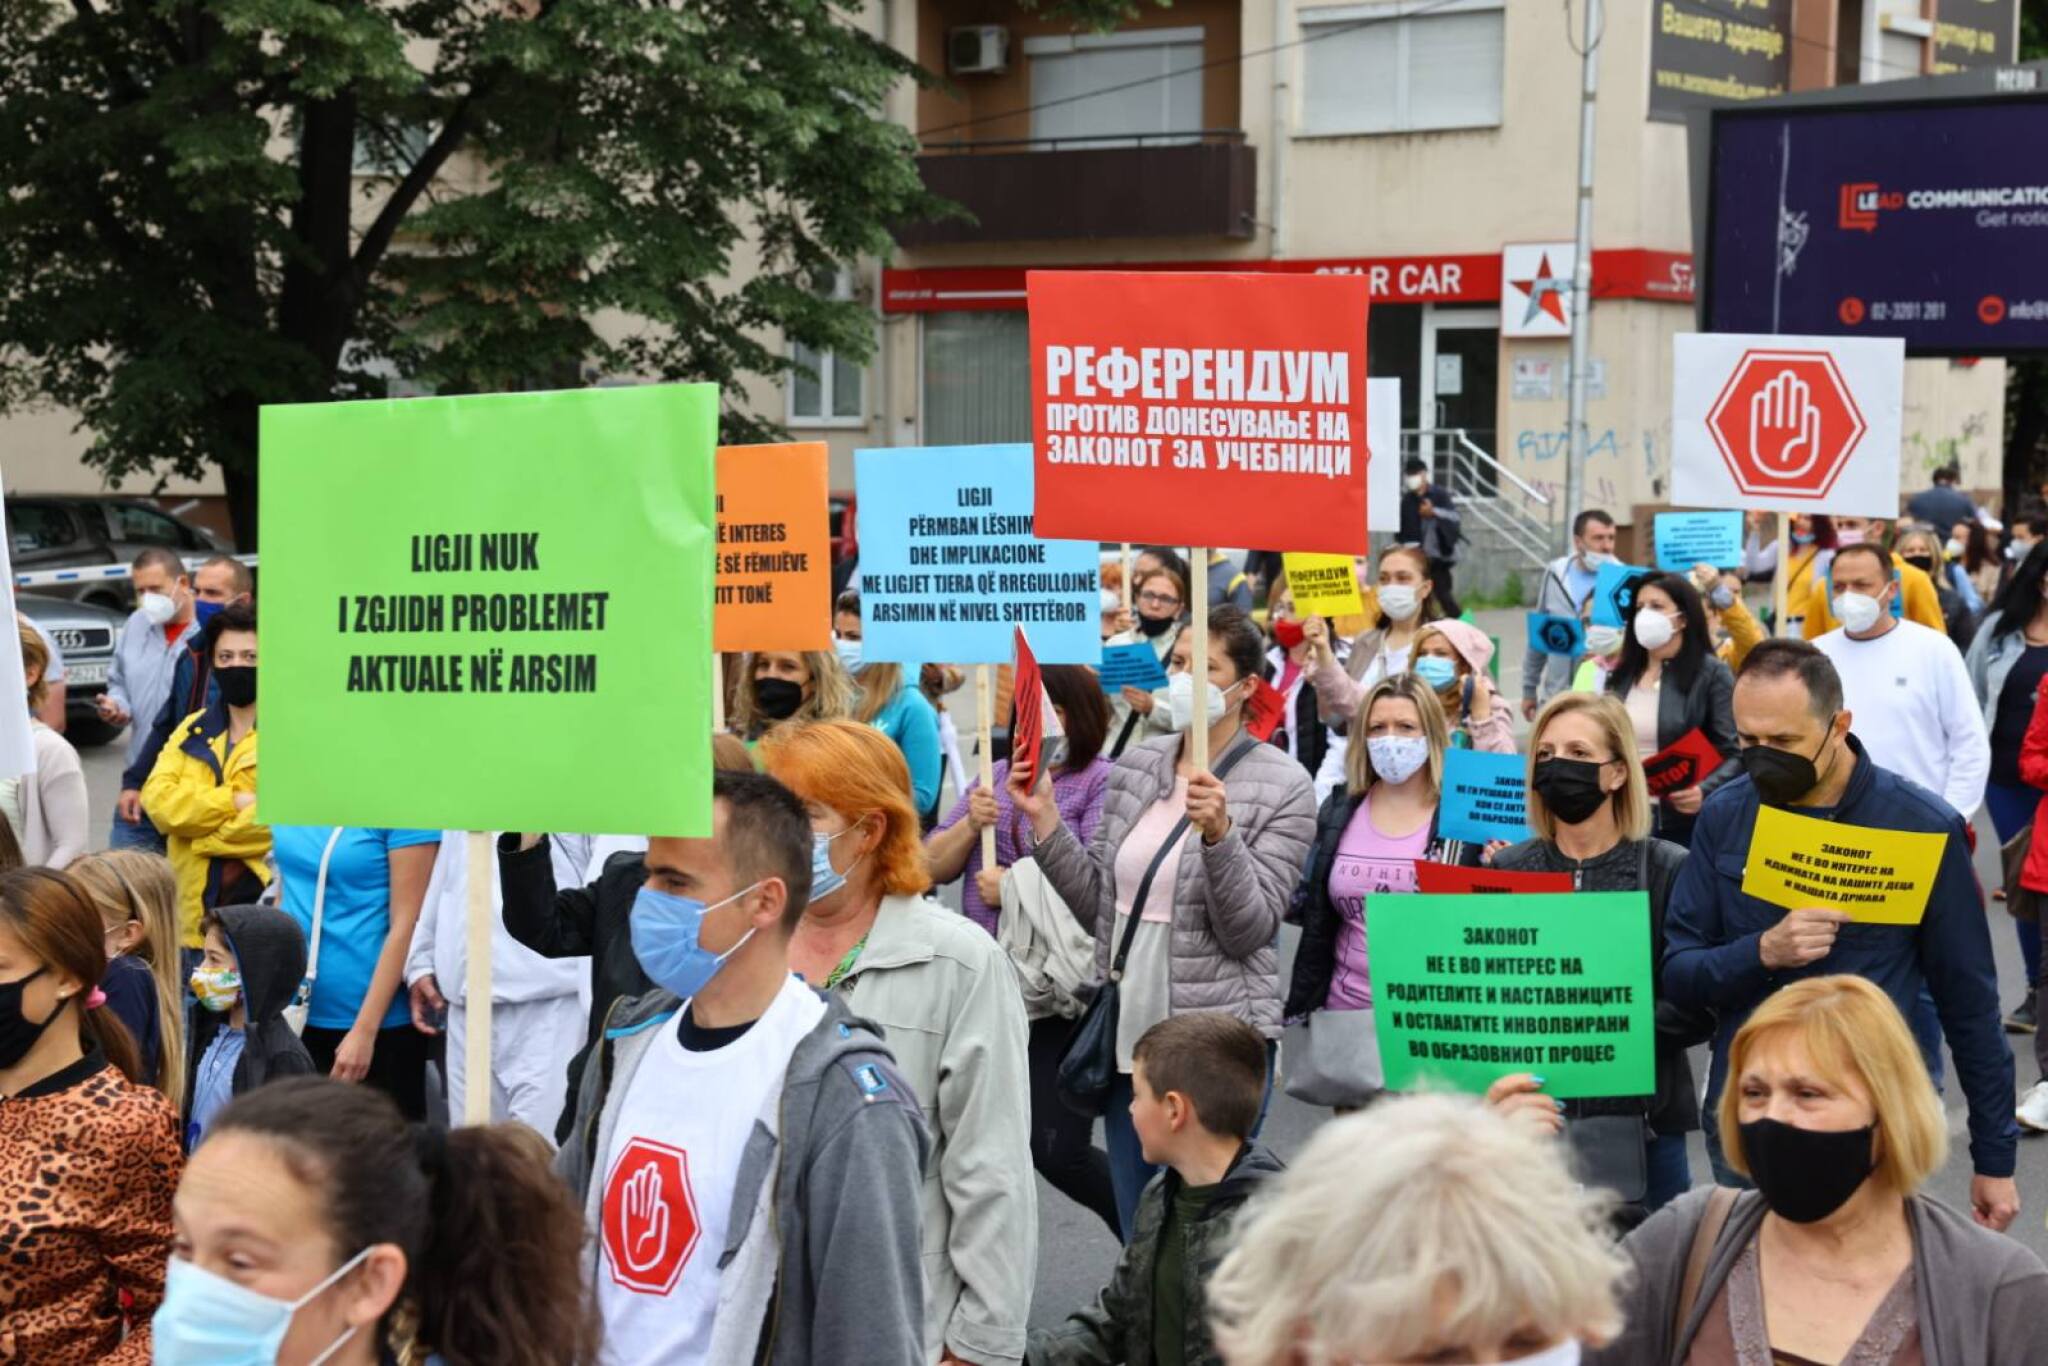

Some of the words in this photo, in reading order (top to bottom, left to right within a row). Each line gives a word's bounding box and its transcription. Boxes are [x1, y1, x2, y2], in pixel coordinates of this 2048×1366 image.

[1662, 2, 1723, 43] Вашето
[1858, 191, 1904, 211] LEAD
[1976, 210, 2007, 228] Get
[1400, 263, 1462, 296] CAR
[1046, 345, 1349, 405] РЕФЕРЕНДУМ
[1046, 402, 1140, 435] ПРОТИВ
[1145, 405, 1312, 440] ДОНЕСУВАЊЕ
[1317, 411, 1350, 441] НА
[1046, 434, 1162, 468] ЗАКОНОТ
[1172, 439, 1206, 469] ЗА
[1216, 441, 1351, 479] УЧЕБНИЦИ
[957, 487, 992, 507] LIGJI
[729, 523, 786, 543] INTERES
[909, 514, 979, 537] PËRMBAN
[411, 534, 472, 572] LIGJI
[480, 532, 539, 571] NUK
[724, 552, 741, 574] SË
[744, 551, 808, 573] FËMIJËVE
[910, 545, 938, 565] DHE
[941, 544, 1046, 565] IMPLIKACIONE
[737, 582, 772, 604] TONË
[862, 575, 882, 594] ME
[885, 574, 930, 594] LIGJET
[934, 573, 974, 593] TJERA
[978, 570, 996, 595] QË
[1000, 569, 1097, 593] RREGULLOJNË
[339, 596, 347, 633] I
[354, 595, 444, 633] ZGJIDH
[452, 592, 609, 632] PROBLEMET
[872, 603, 935, 622] ARSIMIN
[940, 599, 957, 622] NË
[959, 602, 1000, 622] NIVEL
[1003, 599, 1086, 622] SHTETËROR
[346, 654, 463, 693] AKTUALE
[470, 648, 503, 693] NË
[509, 654, 597, 693] ARSIM
[1791, 851, 1804, 864] НЕ
[1805, 854, 1813, 866] Е
[1814, 855, 1829, 868] ВО
[1831, 860, 1878, 876] ИНТЕРЕС
[1880, 866, 1894, 876] НА
[1821, 843, 1872, 860] ЗАКОНОТ
[1764, 857, 1821, 882] ИДНИНАТА
[1823, 874, 1837, 886] НА
[1839, 878, 1883, 891] НАШИТЕ
[1884, 880, 1915, 891] ДЕЦА
[1784, 879, 1792, 889] И
[1794, 881, 1838, 901] НАШАТА
[1839, 891, 1886, 903] ДРЖАВА
[1463, 926, 1539, 946] ЗАКОНОТ
[1426, 955, 1445, 974] НЕ
[1448, 956, 1457, 974] Е
[1460, 956, 1481, 975] ВО
[1485, 956, 1556, 975] ИНТЕРЕС
[1561, 957, 1584, 976] НА
[1387, 982, 1482, 1004] РОДИТЕЛИТЕ
[1486, 985, 1496, 1003] И
[1501, 986, 1633, 1007] НАСТАВНИЦИТЕ
[1392, 1011, 1402, 1029] И
[1405, 1011, 1500, 1034] ОСТАНАТИТЕ
[1503, 1015, 1629, 1035] ИНВОЛВИРАНИ
[1408, 1039, 1429, 1058] ВО
[1431, 1041, 1545, 1064] ОБРАЗОВНИОТ
[1549, 1044, 1616, 1065] ПРОЦЕС
